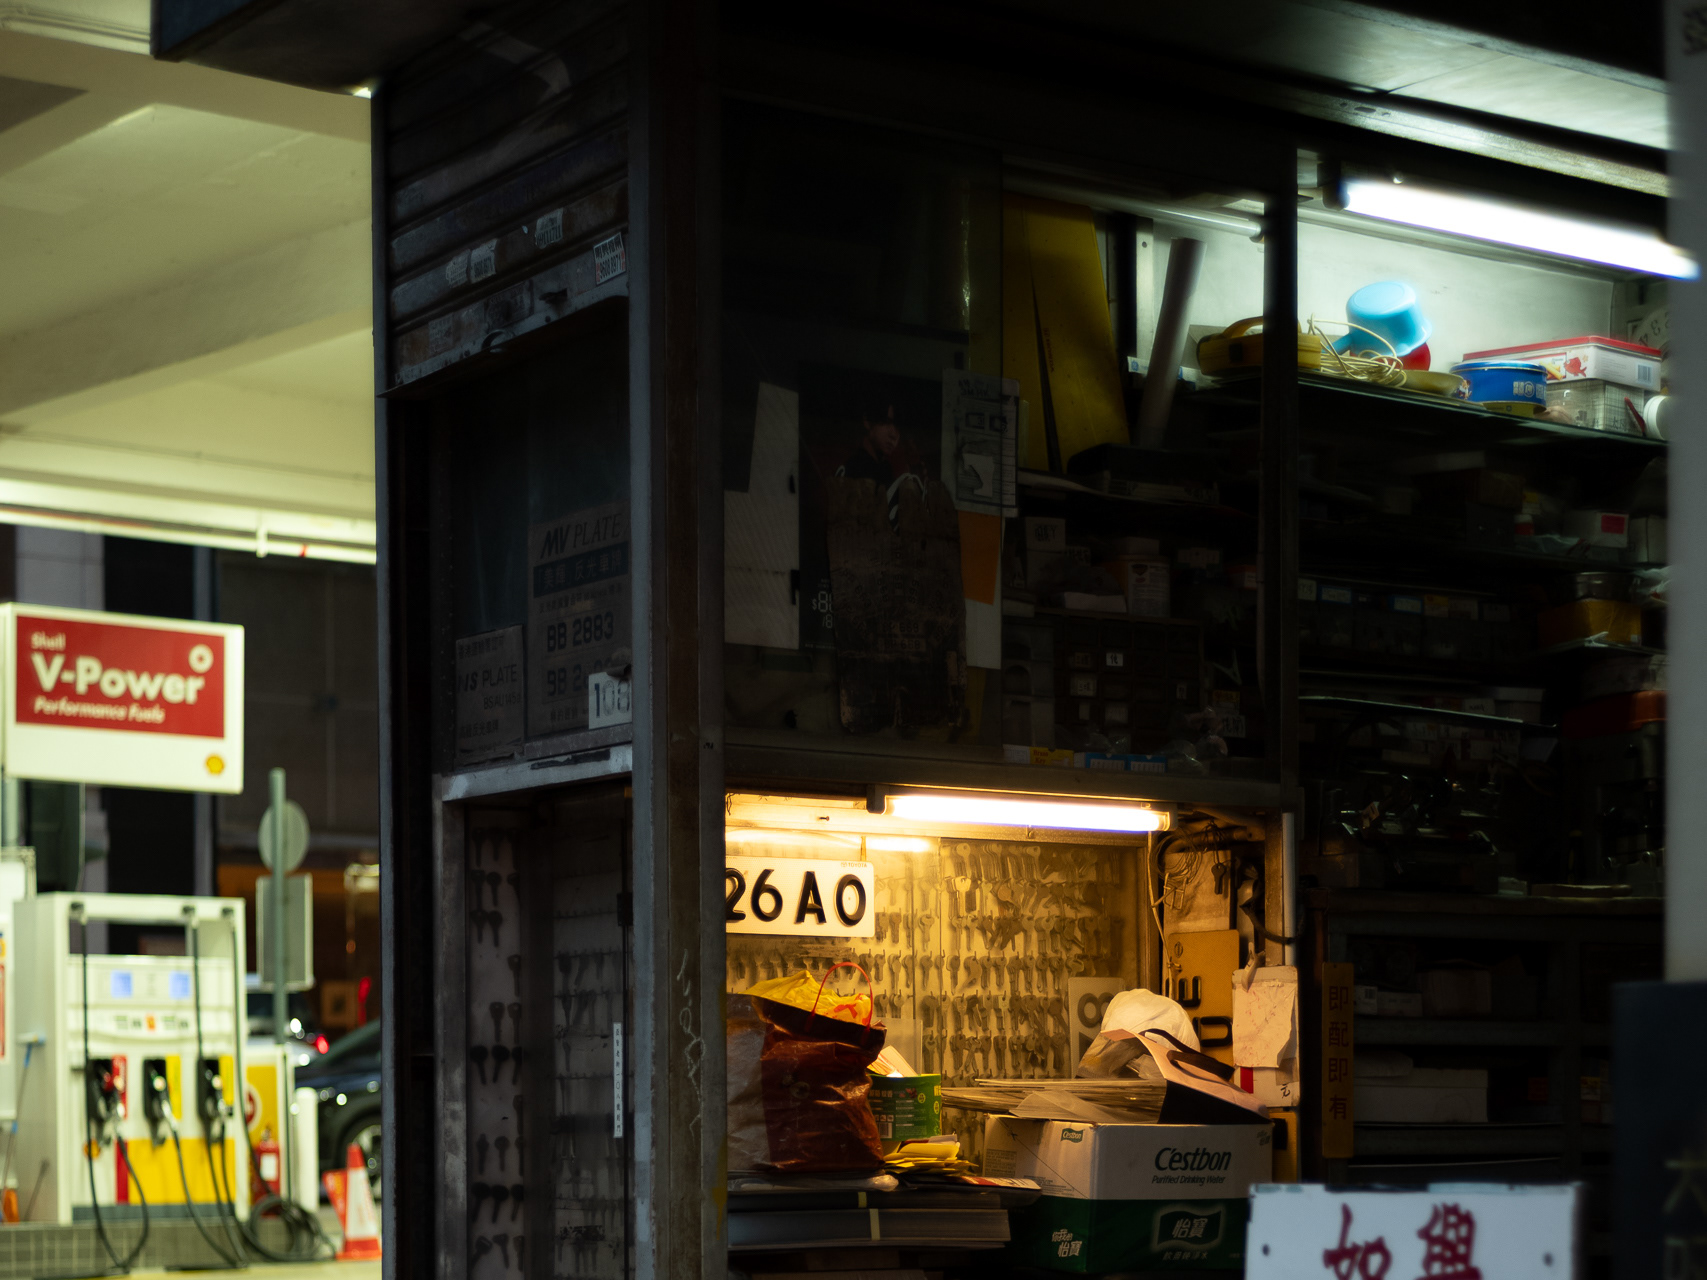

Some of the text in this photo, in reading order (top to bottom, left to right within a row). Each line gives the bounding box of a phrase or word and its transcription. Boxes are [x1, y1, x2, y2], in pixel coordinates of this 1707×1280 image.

[540, 513, 622, 559] MV PLATE
[575, 548, 622, 581] 反光車牌
[547, 611, 614, 652] BB 2883
[31, 652, 206, 705] V-Power
[482, 664, 517, 688] PLATE
[1328, 985, 1349, 1121] 即配即有
[1155, 1147, 1232, 1171] C'estbon
[1152, 1175, 1226, 1187] Purified Drinking Water
[1171, 1217, 1209, 1239] 怡寶
[1057, 1240, 1083, 1258] 怡寶
